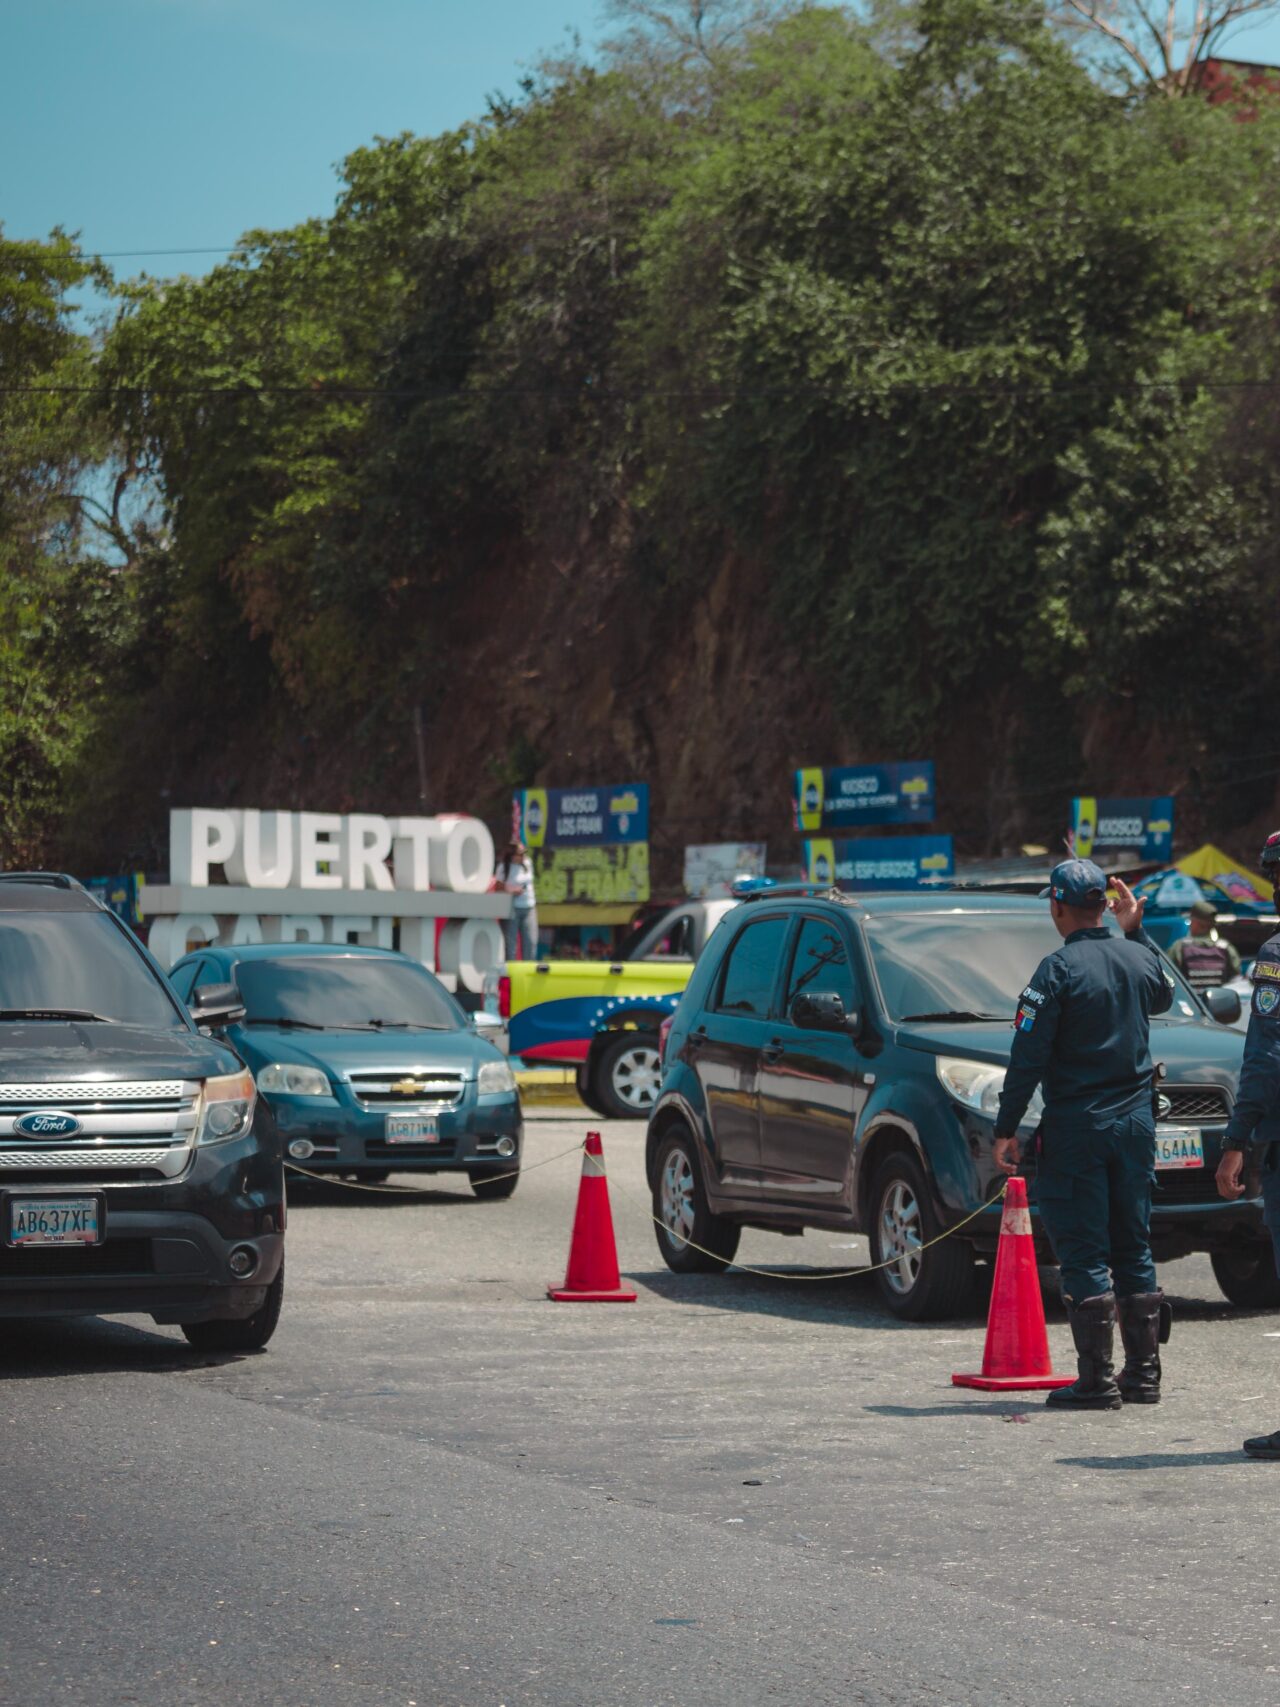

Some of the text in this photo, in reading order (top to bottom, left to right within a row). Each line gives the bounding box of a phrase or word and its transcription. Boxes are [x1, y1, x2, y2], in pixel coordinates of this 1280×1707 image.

[561, 795, 598, 814] KIOSCO
[1098, 816, 1143, 836] KIOSCO
[170, 808, 495, 893] PUERTO
[31, 1116, 67, 1131] Ford
[1155, 1139, 1198, 1160] 64AA
[17, 1209, 92, 1233] AB637XF
